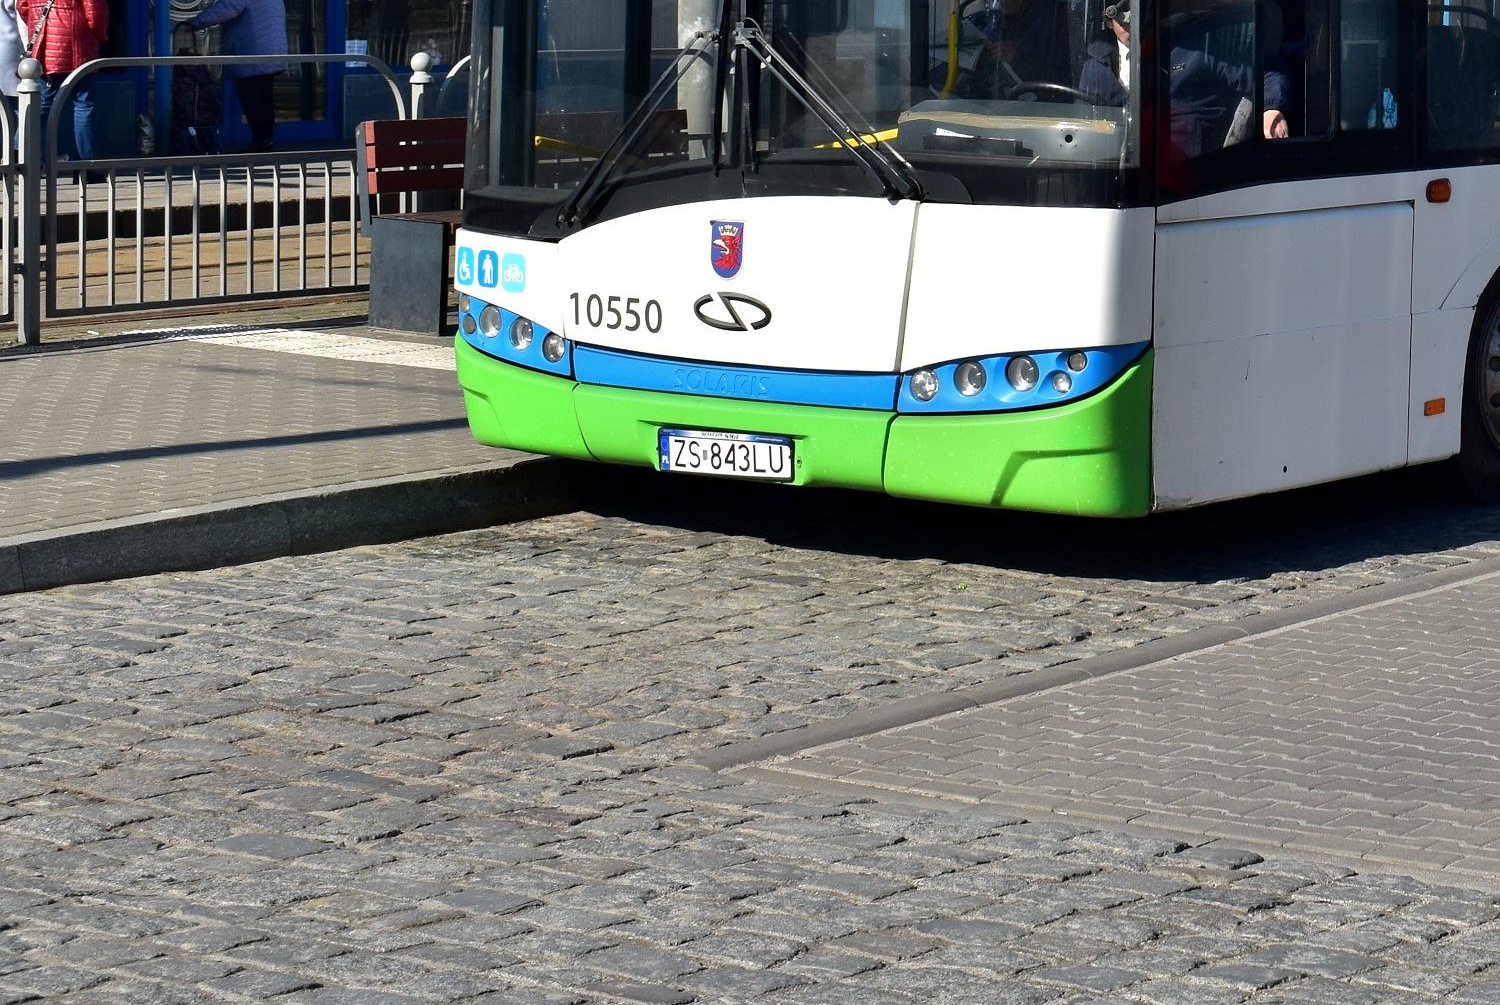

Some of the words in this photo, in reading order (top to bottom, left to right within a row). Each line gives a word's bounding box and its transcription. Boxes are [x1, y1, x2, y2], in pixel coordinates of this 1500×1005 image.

[569, 292, 663, 334] 10550
[673, 368, 771, 398] SOLARIS
[710, 442, 784, 474] 843LU
